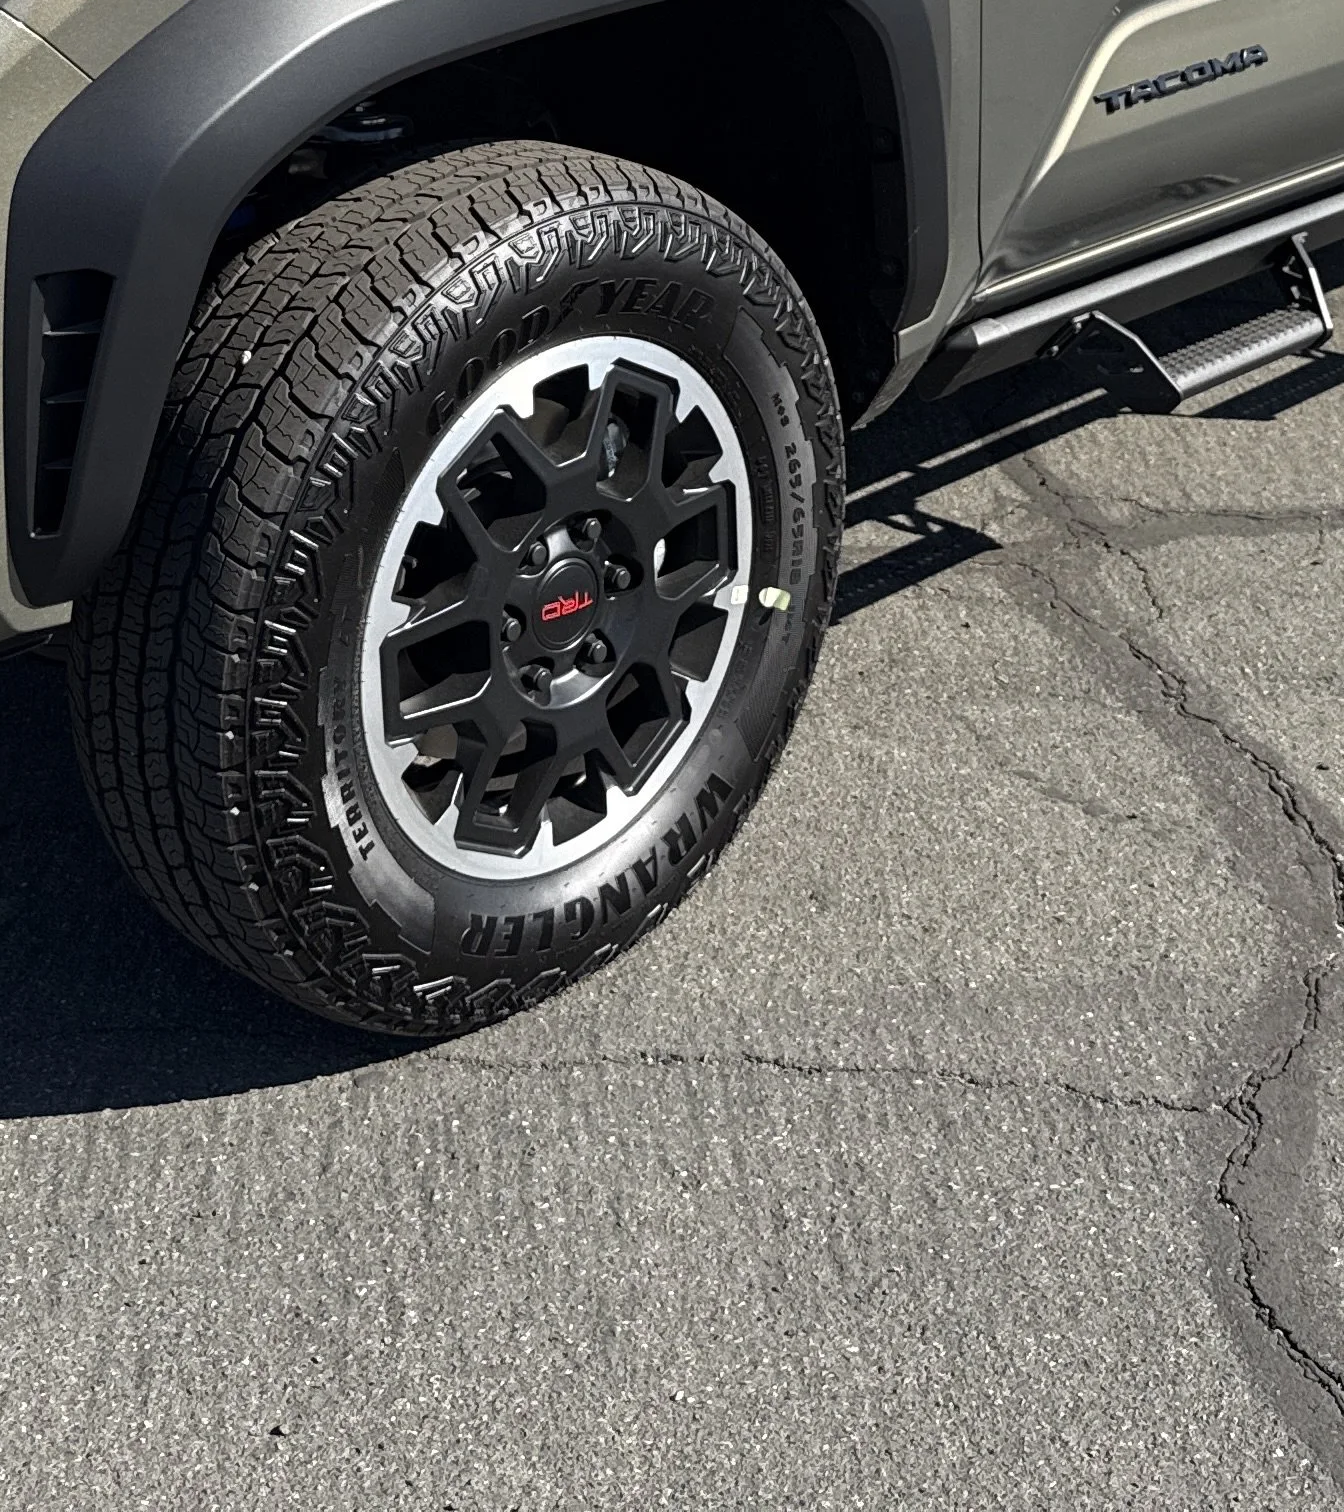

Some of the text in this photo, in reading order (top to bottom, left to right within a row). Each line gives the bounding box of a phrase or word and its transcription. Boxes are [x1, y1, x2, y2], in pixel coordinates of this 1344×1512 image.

[1093, 44, 1268, 115] TACOMA
[426, 277, 716, 435] GOODYEAR
[542, 589, 594, 621] TRD
[332, 677, 377, 862] TERRITORY
[460, 772, 734, 958] WRANGLER
